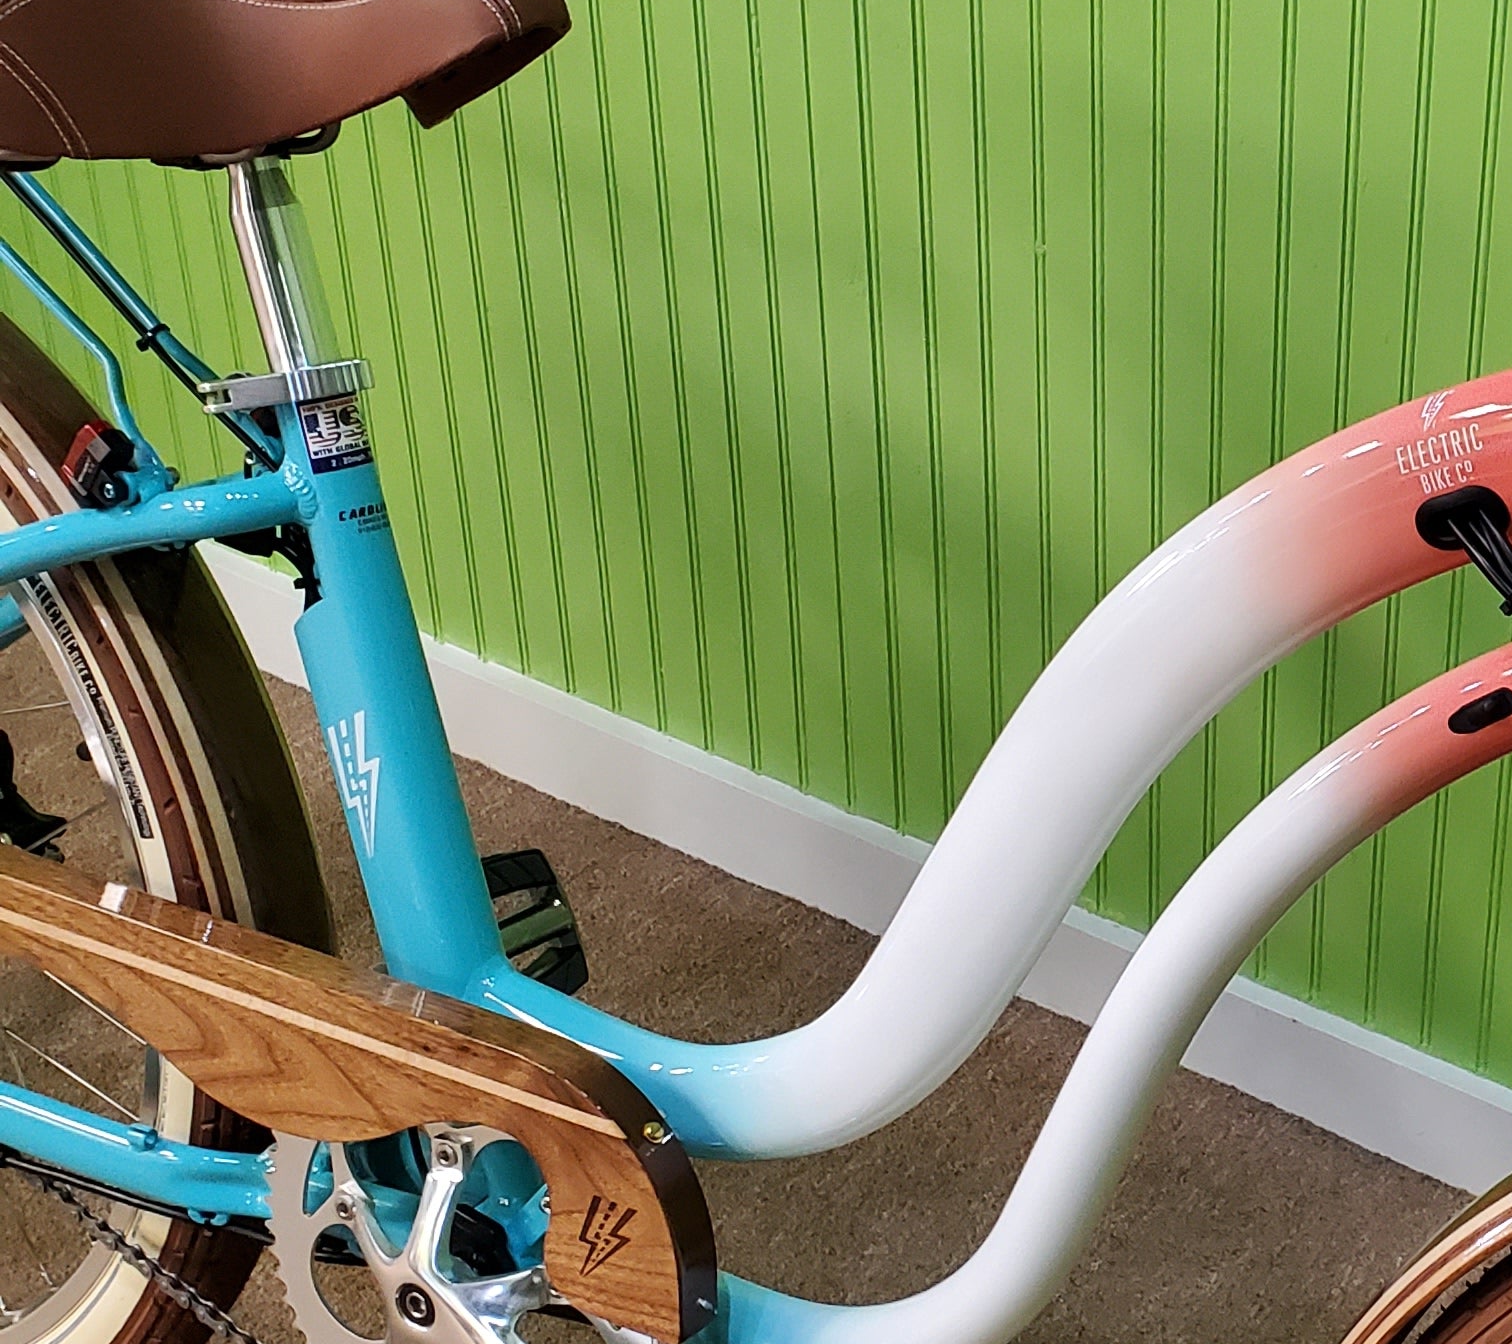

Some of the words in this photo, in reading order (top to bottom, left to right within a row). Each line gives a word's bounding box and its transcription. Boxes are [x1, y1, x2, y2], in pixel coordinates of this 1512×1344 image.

[312, 446, 334, 457] WITH
[335, 442, 361, 453] GLOBAL
[1396, 423, 1484, 475] ELECTRIC
[1420, 466, 1455, 495] BIKE
